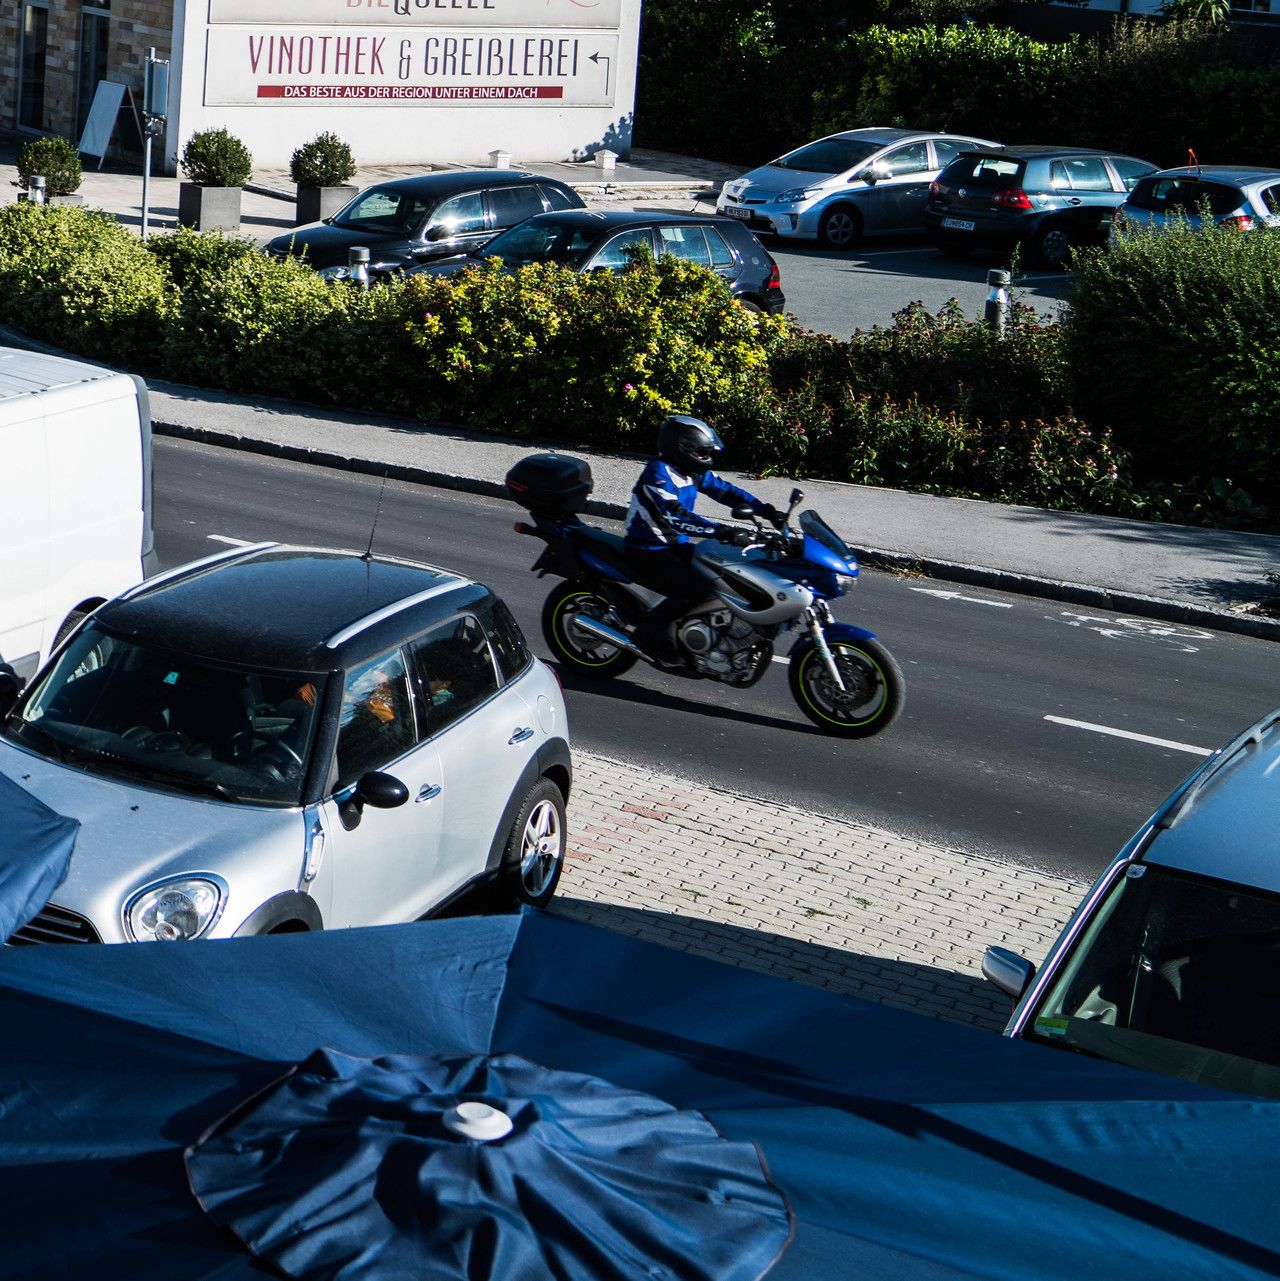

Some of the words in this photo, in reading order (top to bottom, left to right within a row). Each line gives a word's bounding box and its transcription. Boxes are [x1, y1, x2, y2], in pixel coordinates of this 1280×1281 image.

[248, 35, 386, 75] VINOTHEK
[398, 39, 412, 80] &
[284, 86, 307, 97] DAS
[309, 86, 342, 97] BESTE
[343, 86, 366, 98] AUS
[368, 87, 390, 98] DER
[392, 87, 433, 98] REGION
[435, 87, 470, 98] UNTER
[472, 87, 505, 98] EINEM
[507, 87, 538, 98] DACH
[661, 511, 715, 534] X-race
